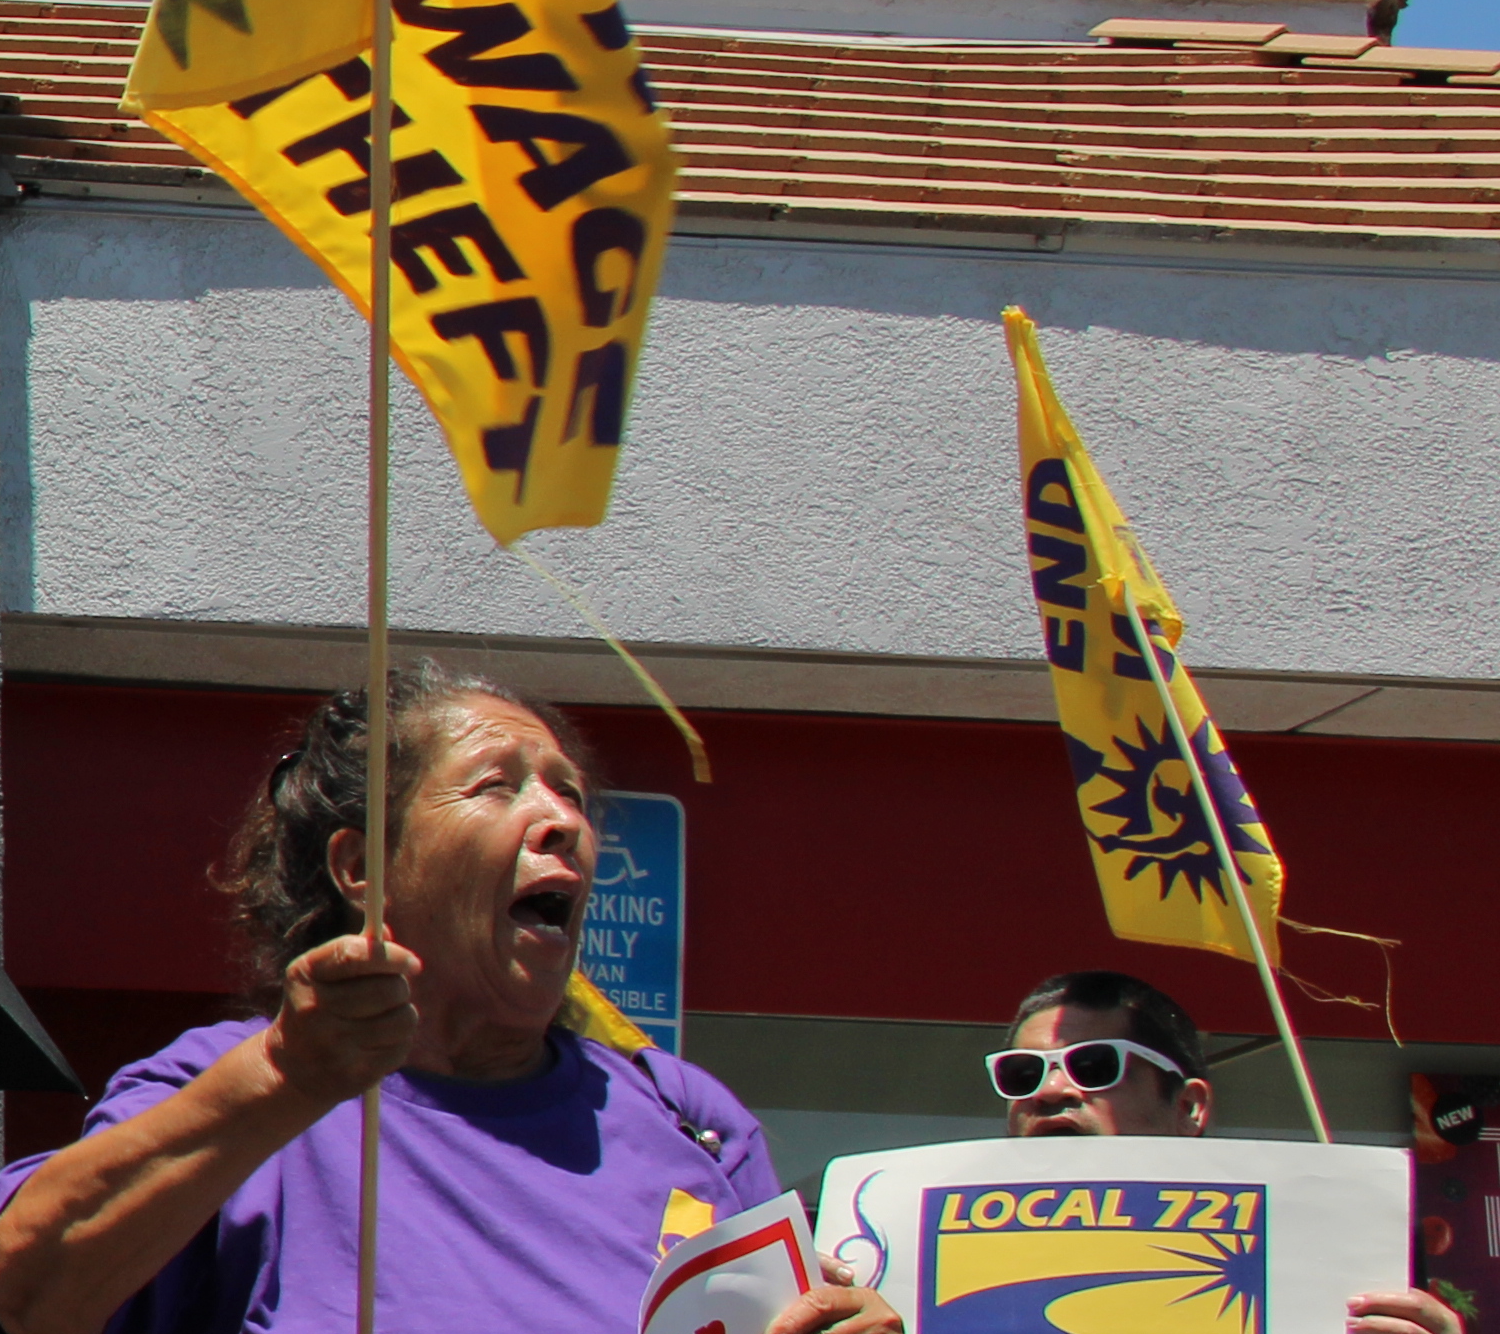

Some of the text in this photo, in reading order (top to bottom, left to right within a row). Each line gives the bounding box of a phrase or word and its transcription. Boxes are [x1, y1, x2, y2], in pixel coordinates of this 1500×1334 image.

[584, 893, 664, 926] RKING
[1437, 1104, 1474, 1131] NEW
[938, 1188, 1258, 1232] LOCAL 721
